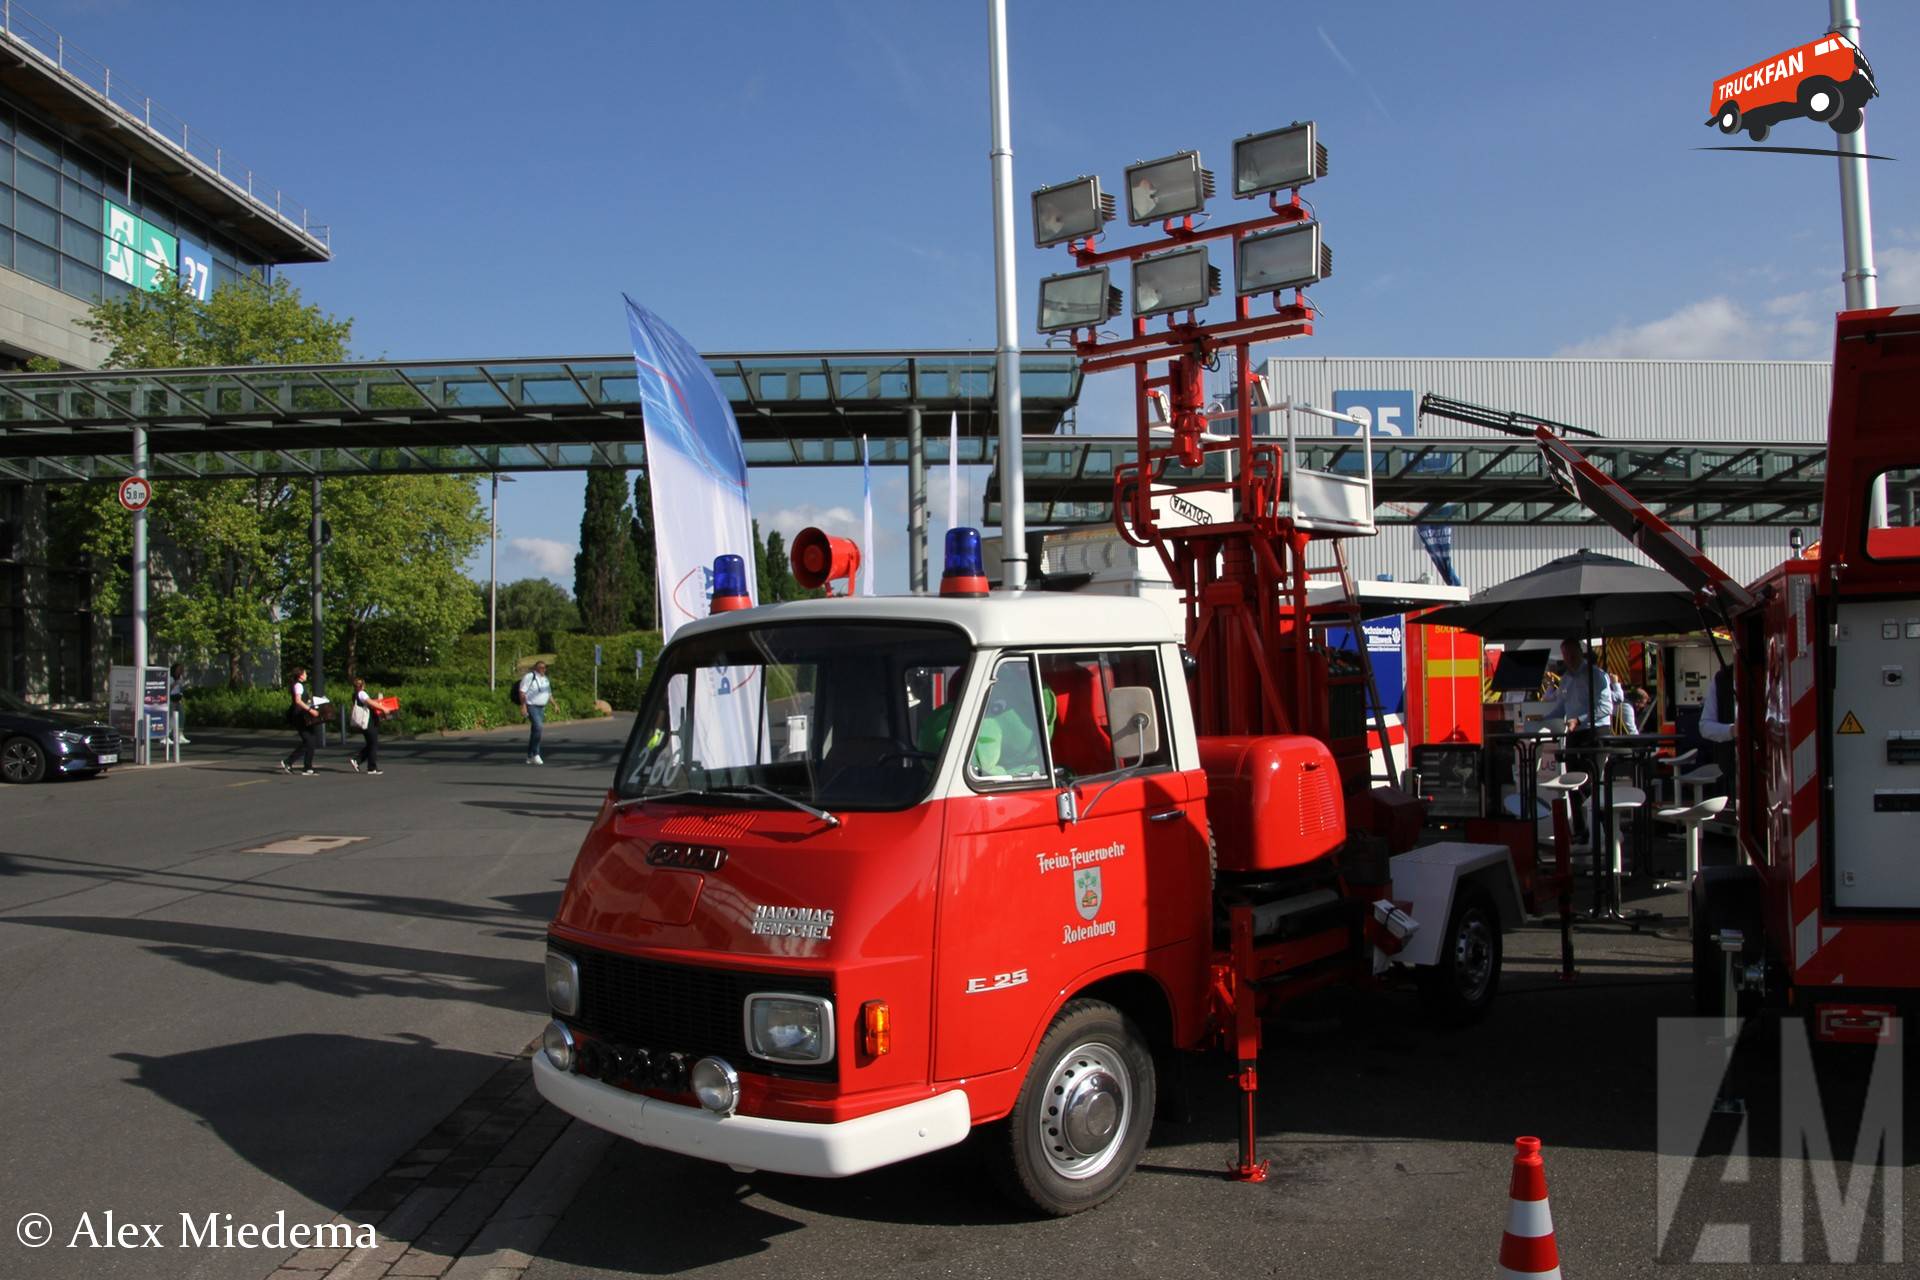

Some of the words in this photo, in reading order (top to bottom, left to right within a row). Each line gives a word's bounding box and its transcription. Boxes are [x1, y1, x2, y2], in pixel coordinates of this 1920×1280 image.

[184, 256, 208, 301] 27
[1346, 406, 1402, 436] 25
[1173, 496, 1210, 526] POLYMA
[1070, 841, 1126, 869] Feuerwehr
[755, 905, 835, 926] HANOMAG
[752, 920, 832, 940] HENSCHEL
[1062, 919, 1116, 944] Rotenburg
[966, 978, 987, 993] E
[994, 969, 1029, 988] 25
